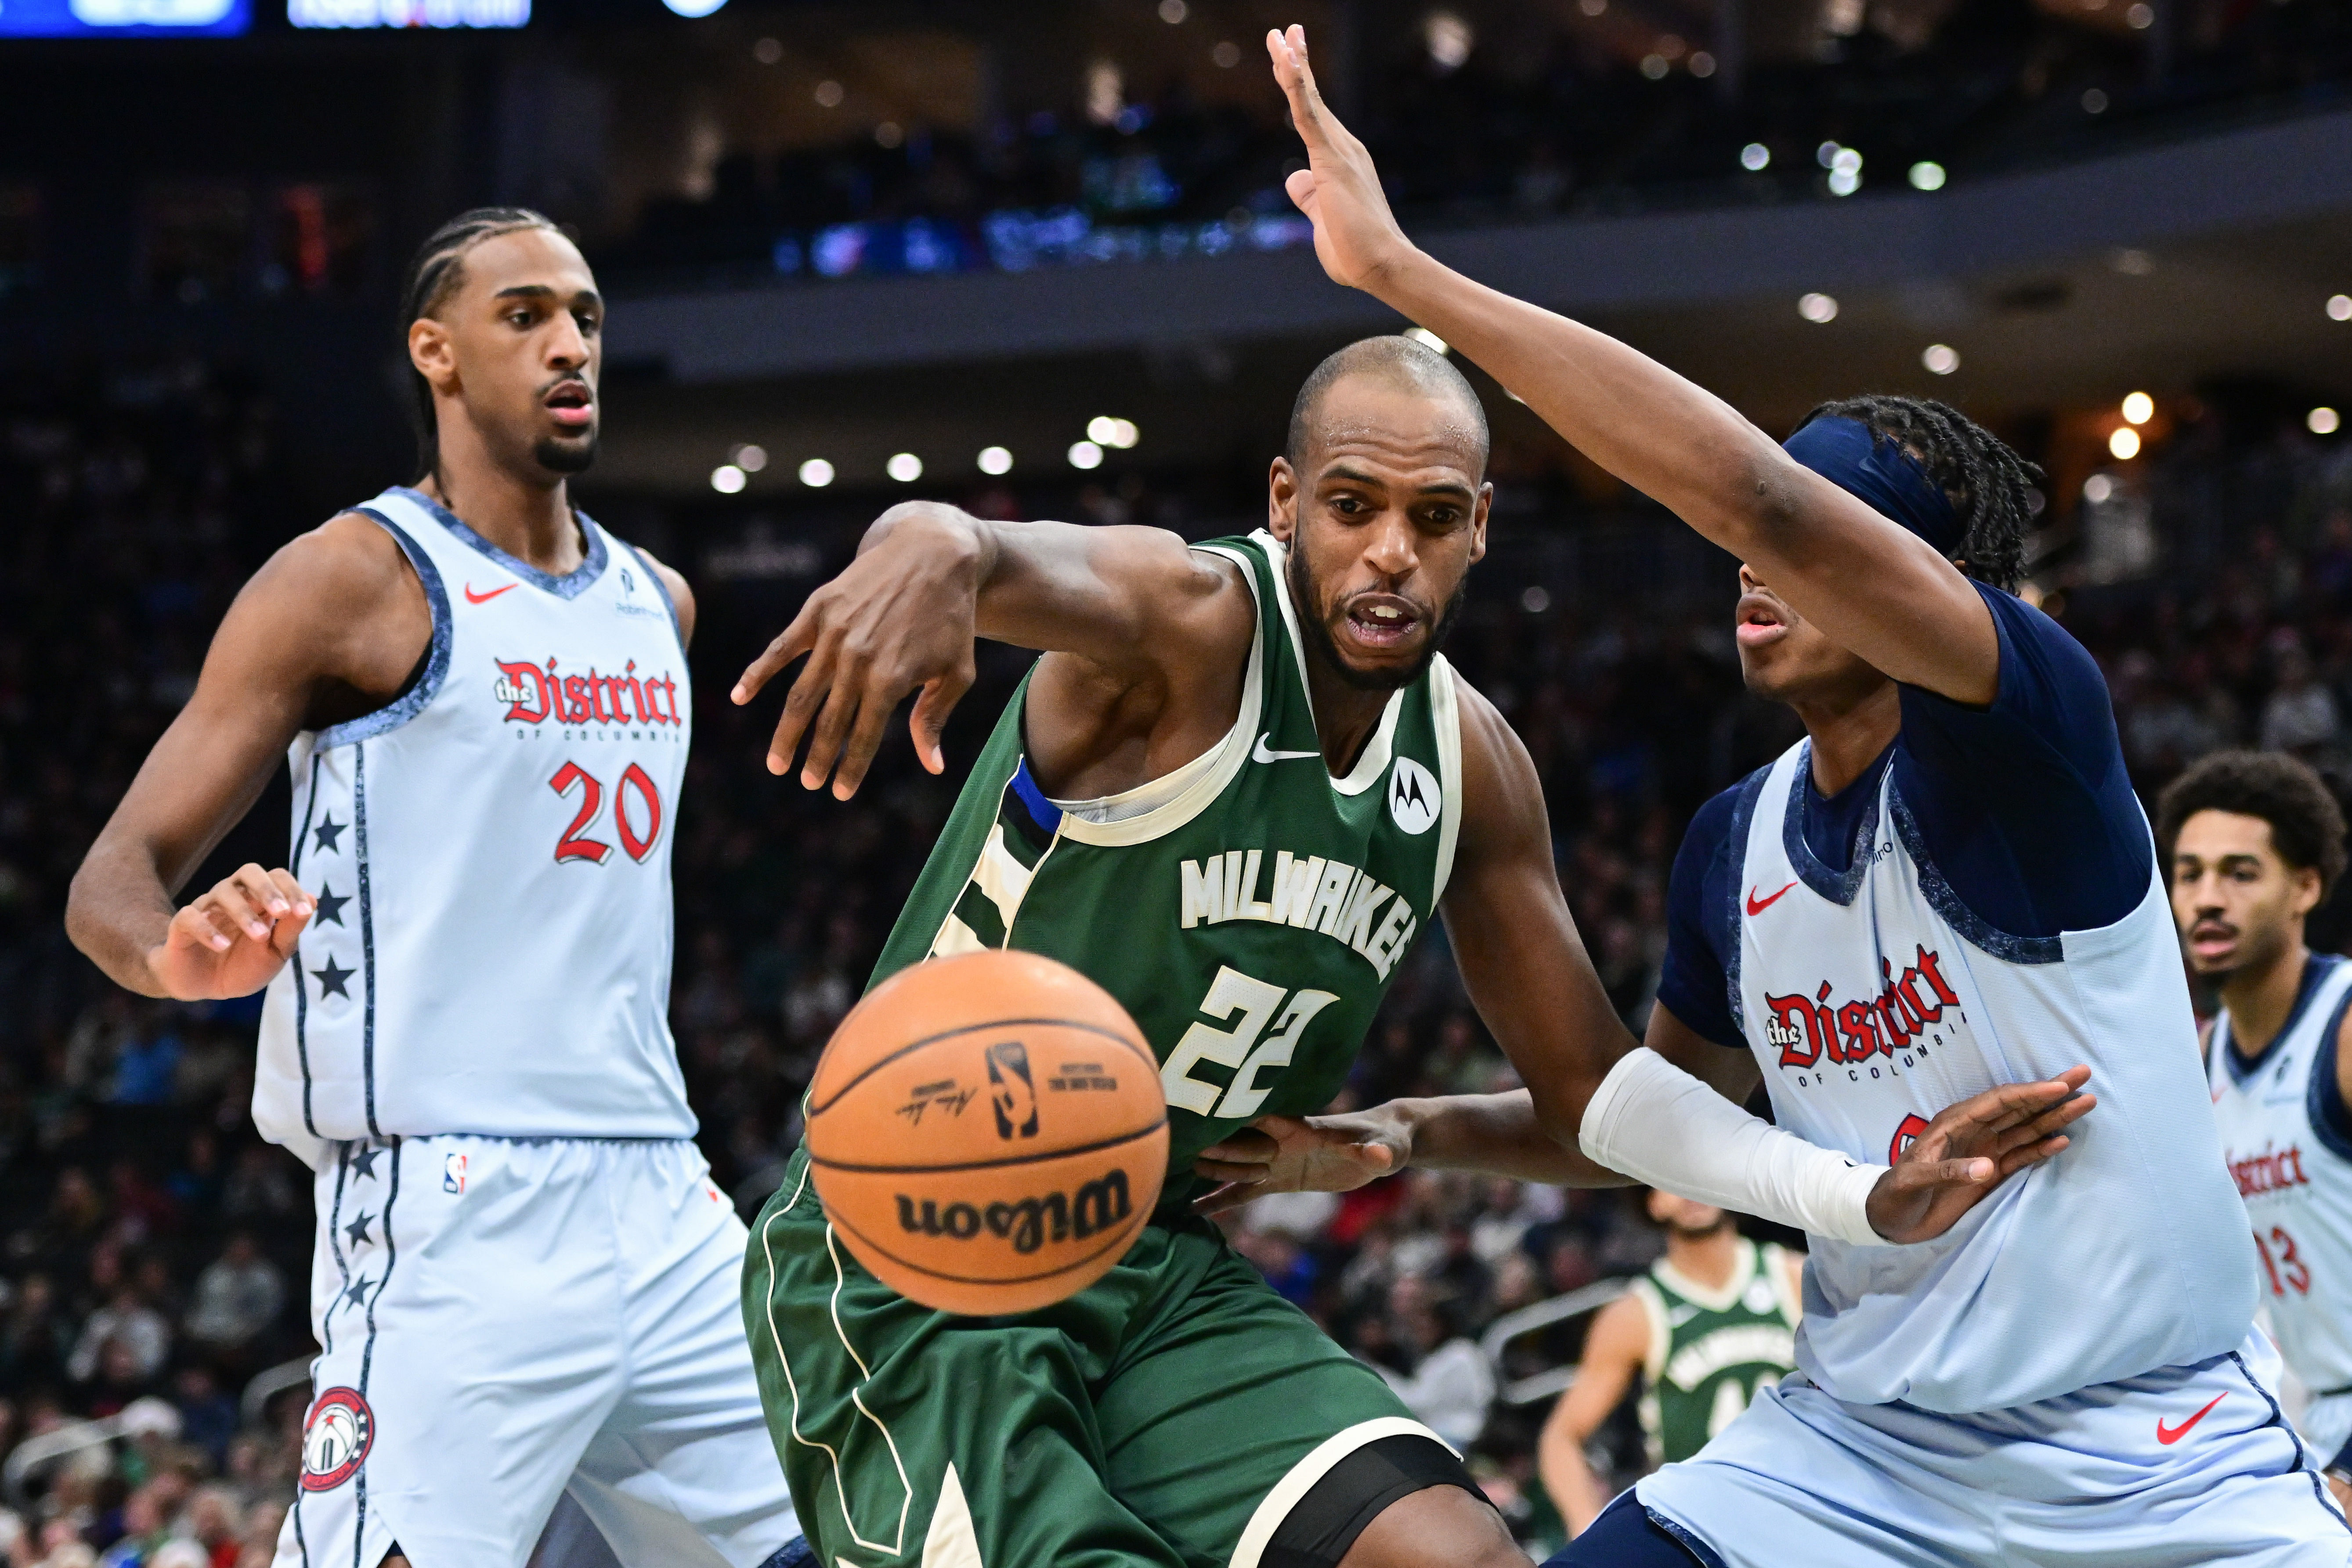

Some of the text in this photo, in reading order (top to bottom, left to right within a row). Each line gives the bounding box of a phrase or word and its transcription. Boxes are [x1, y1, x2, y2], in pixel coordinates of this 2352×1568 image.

[494, 656, 681, 727] the District
[517, 729, 541, 741] OF
[549, 760, 664, 866] 20
[1181, 849, 1417, 984] MILWAKE
[1160, 965, 1341, 1118] 22
[1765, 1015, 1801, 1047] the
[1798, 1073, 1823, 1087] OF
[894, 1168, 1132, 1255] Wilson
